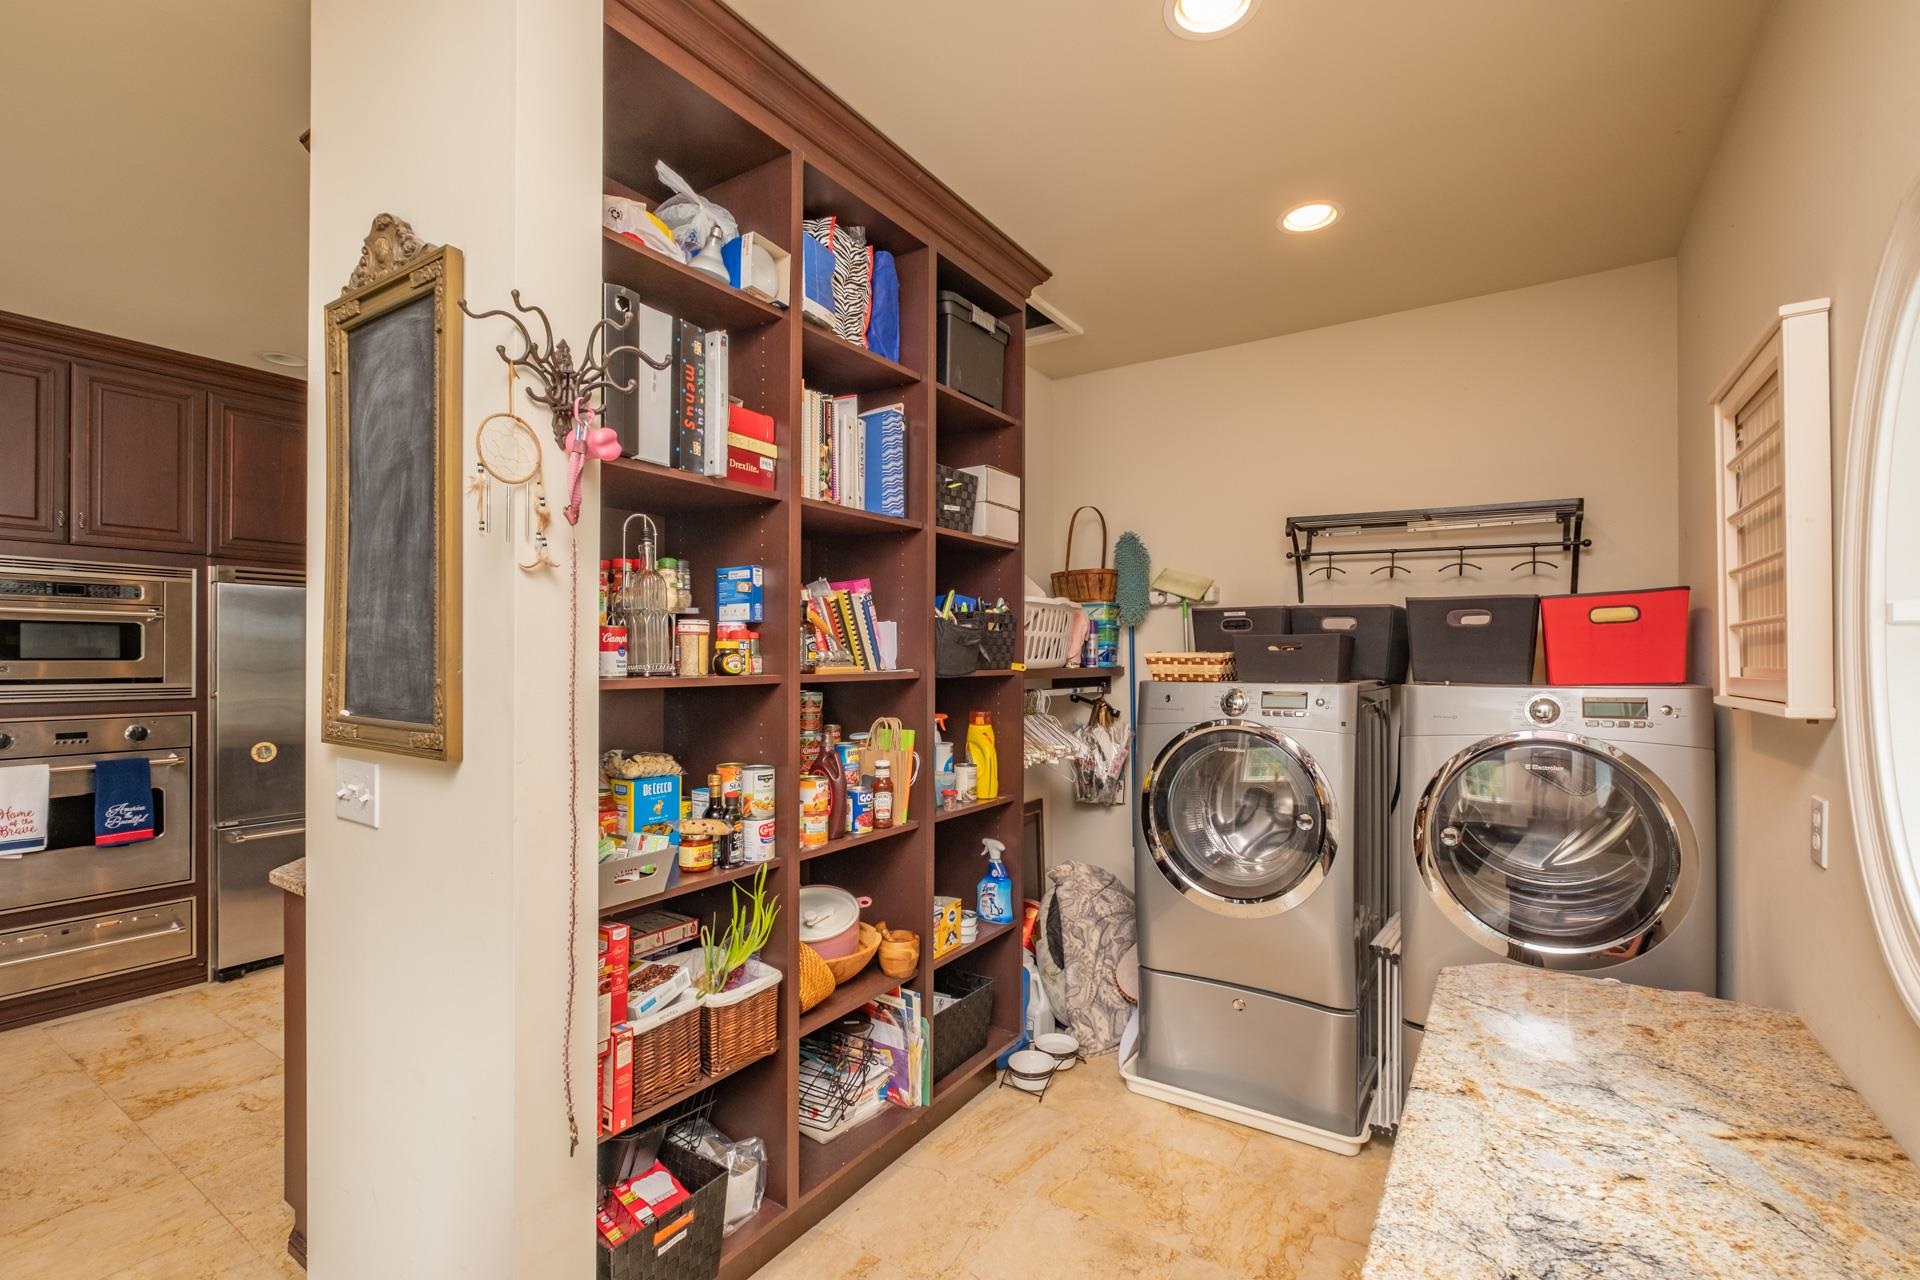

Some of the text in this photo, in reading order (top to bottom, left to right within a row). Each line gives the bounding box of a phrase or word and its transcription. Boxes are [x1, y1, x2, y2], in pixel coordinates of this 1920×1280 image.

[684, 363, 696, 430] menus
[642, 783, 653, 797] DE
[652, 781, 673, 795] CECCO
[859, 793, 872, 803] GO
[0, 806, 34, 821] Home
[105, 802, 146, 818] America
[104, 813, 150, 829] Beautiful
[0, 825, 38, 838] Brave
